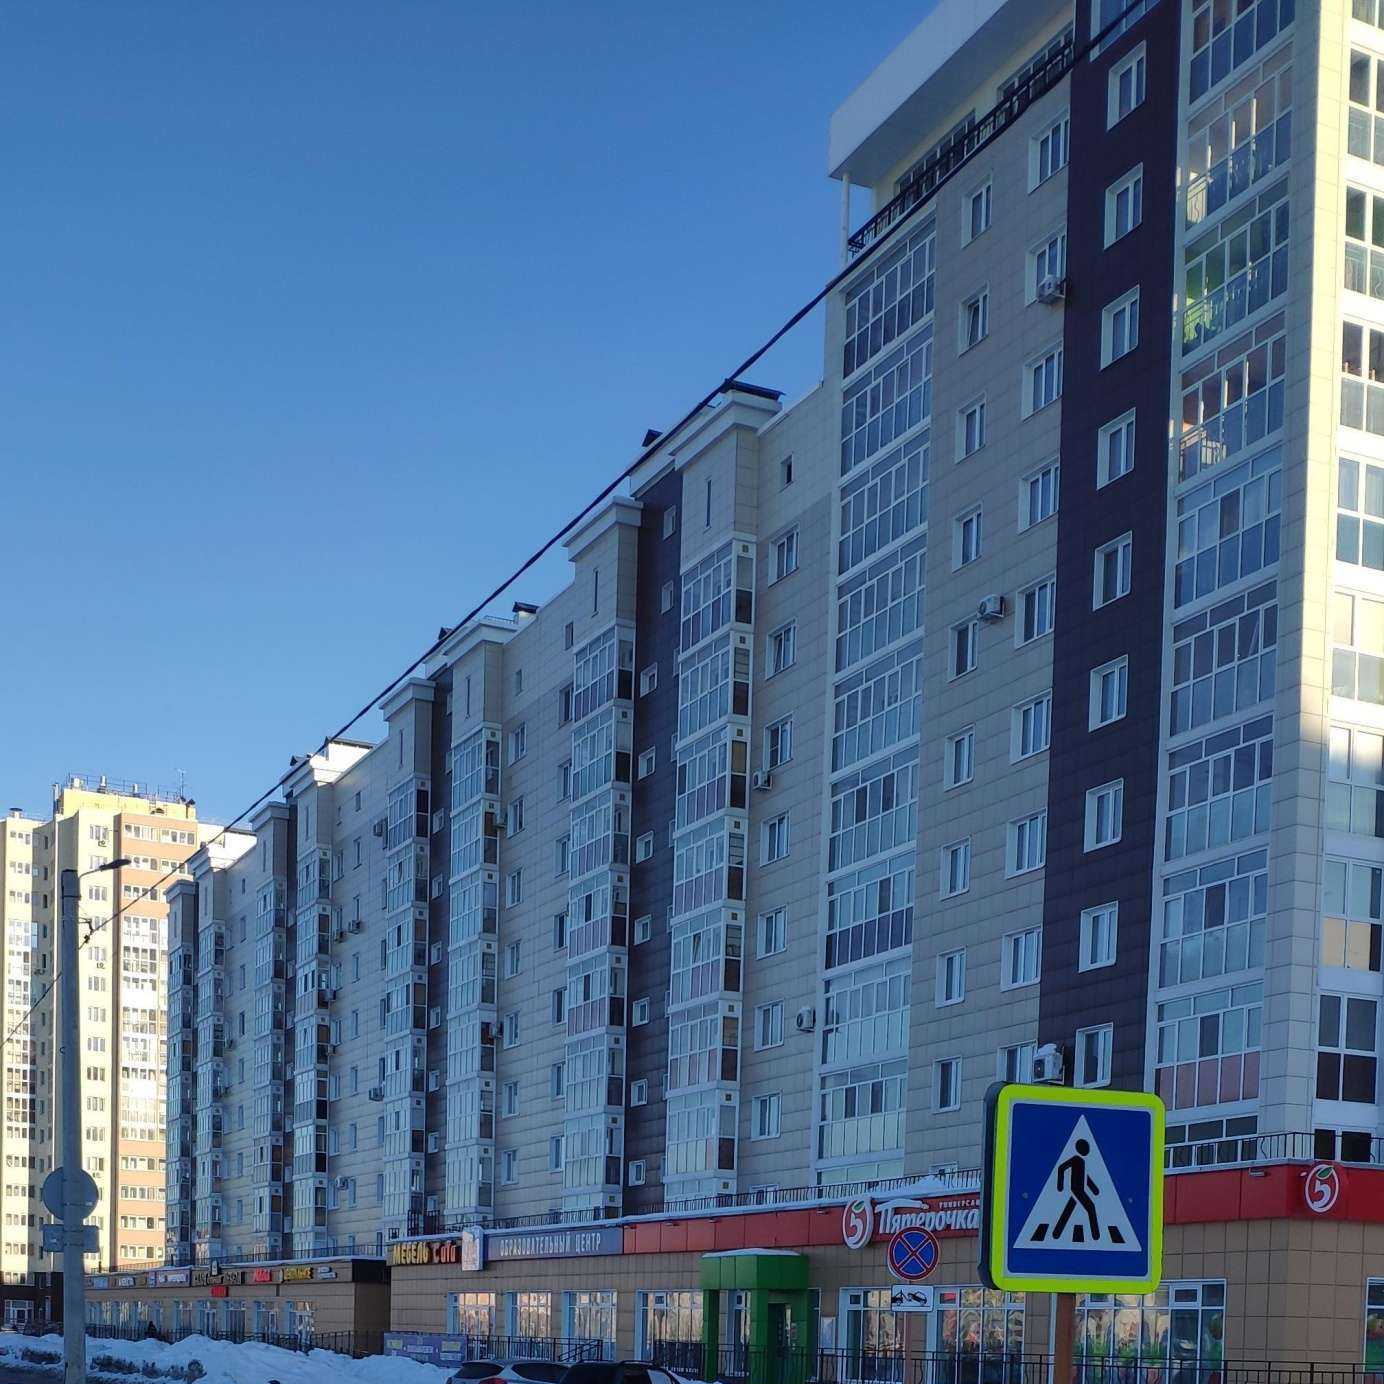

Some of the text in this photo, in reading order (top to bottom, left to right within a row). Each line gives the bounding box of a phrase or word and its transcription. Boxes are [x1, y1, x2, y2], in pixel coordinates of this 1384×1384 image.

[393, 1241, 429, 1264] МЕБЕЛЬ
[500, 1232, 570, 1257] ОБРАЗОВАТЕЛЬНЫЙ
[575, 1232, 601, 1254] ЦЕНТР
